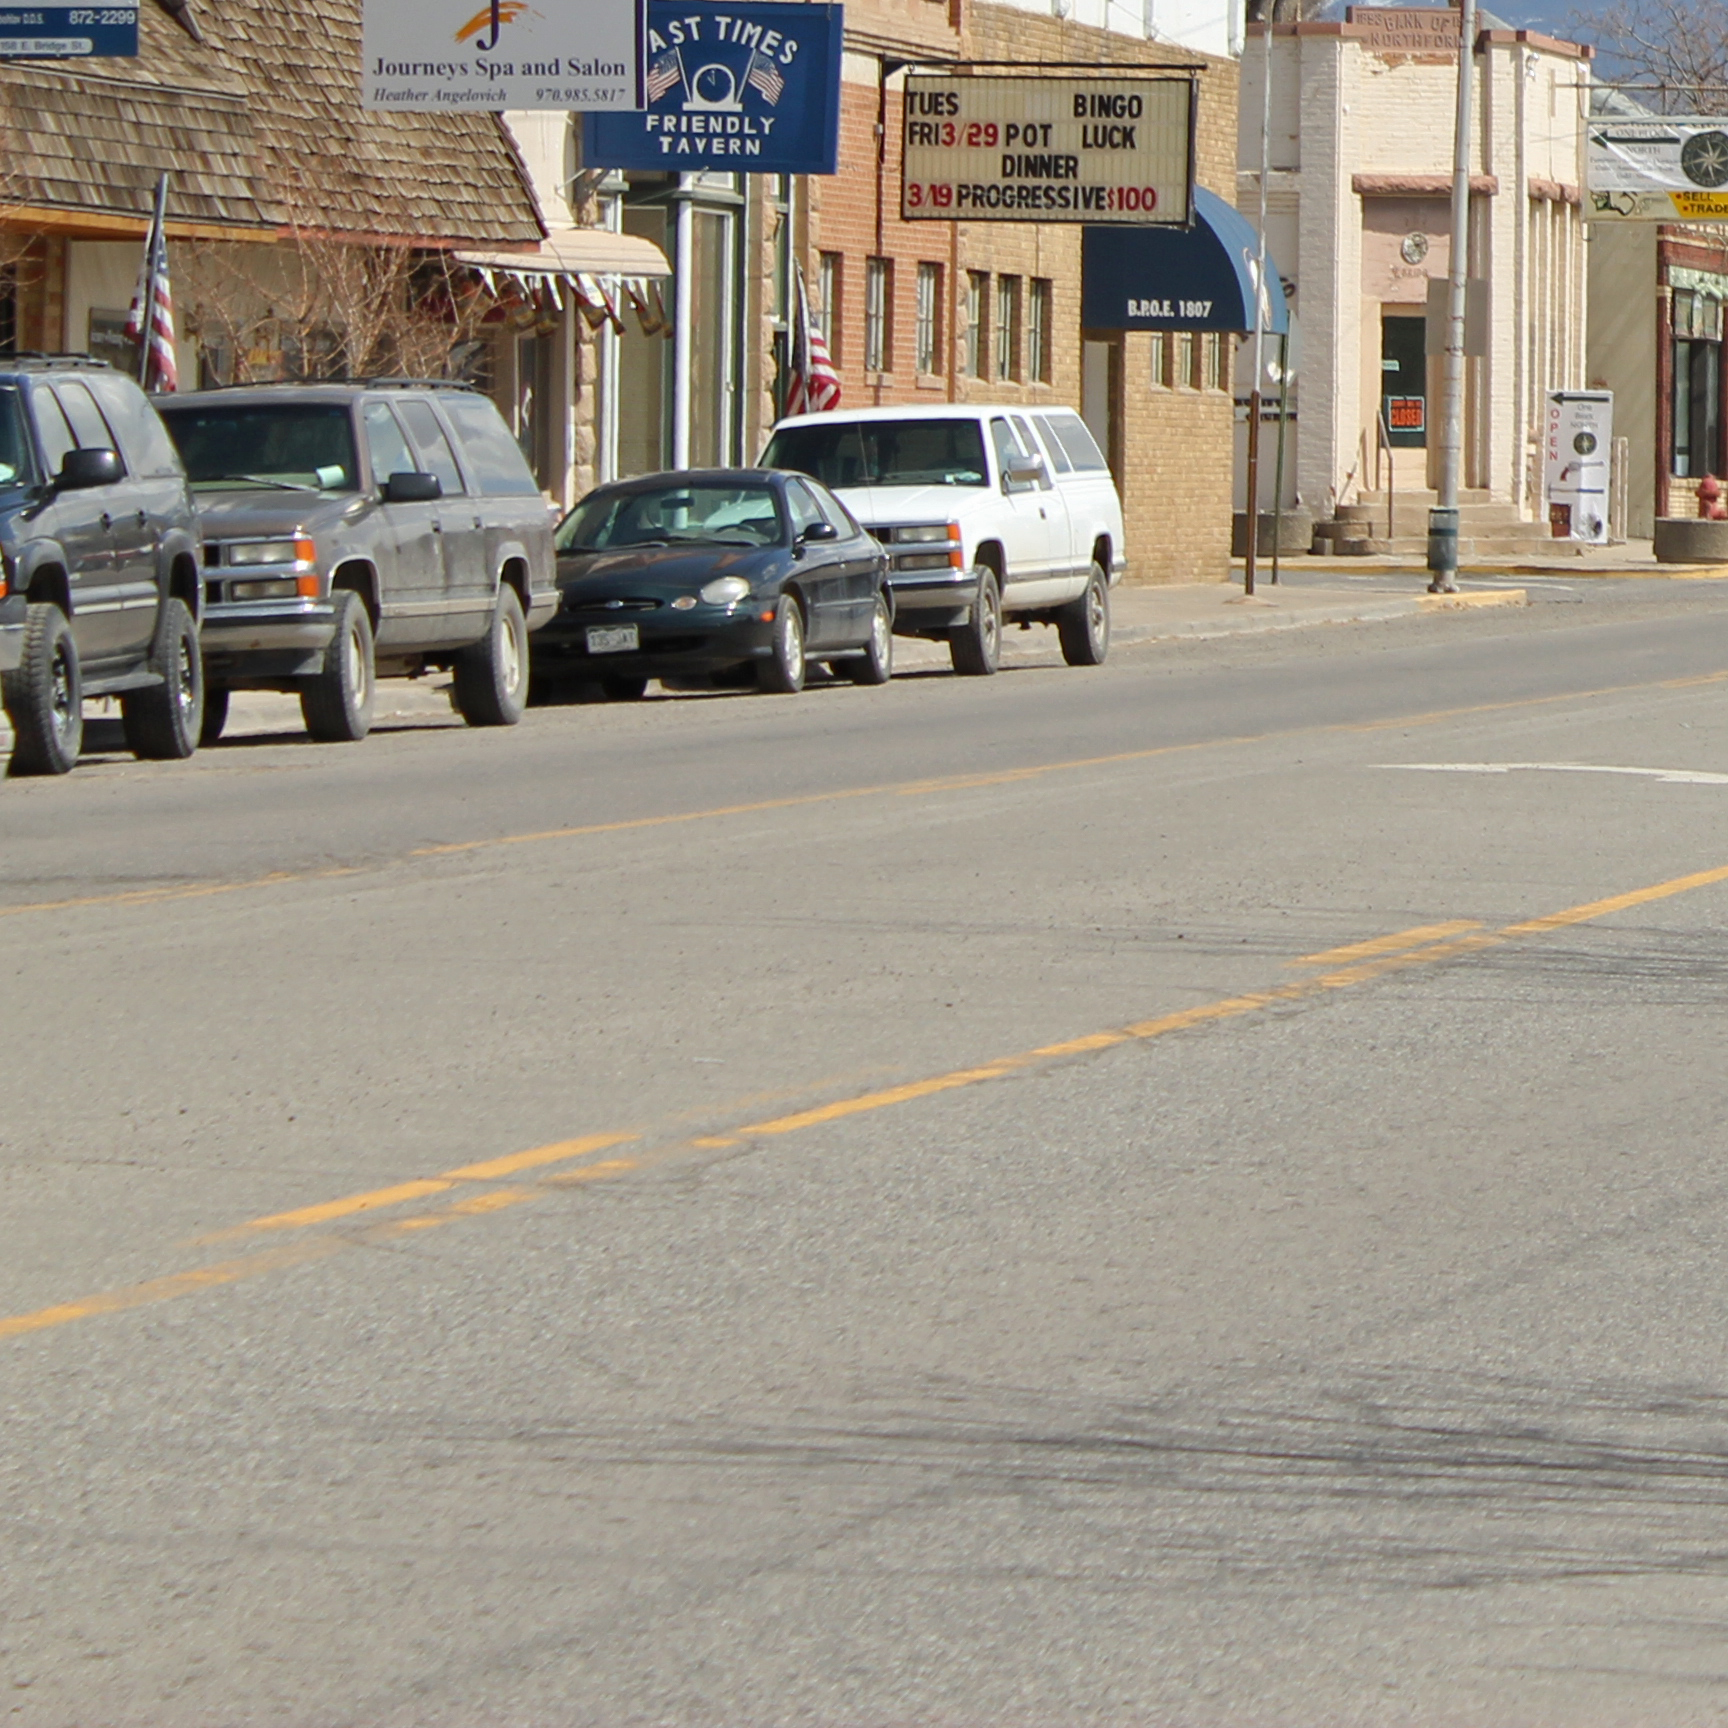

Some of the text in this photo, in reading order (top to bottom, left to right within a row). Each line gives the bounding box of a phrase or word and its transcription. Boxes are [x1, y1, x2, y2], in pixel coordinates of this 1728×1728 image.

[69, 10, 136, 25] 872-2299
[1384, 12, 1423, 32] BANK
[1431, 15, 1450, 33] OF
[34, 39, 67, 52] Bridge
[648, 15, 798, 64] AST TIMES
[373, 58, 626, 81] Journeys Spa and Salon
[373, 88, 626, 105] Heather Angelovich 970.985.5817
[907, 91, 1143, 118] TUES BINGO
[646, 115, 776, 135] FRIENDLY
[659, 136, 761, 155] TAVERN
[1005, 124, 1053, 148] POT
[1082, 125, 1137, 149] LUCK
[1002, 154, 1078, 180] DINNER
[907, 183, 952, 208] 3/19
[1683, 191, 1714, 202] SELL
[1127, 299, 1212, 318] B.P.O.E. 1807
[1549, 408, 1561, 462] OPEN
